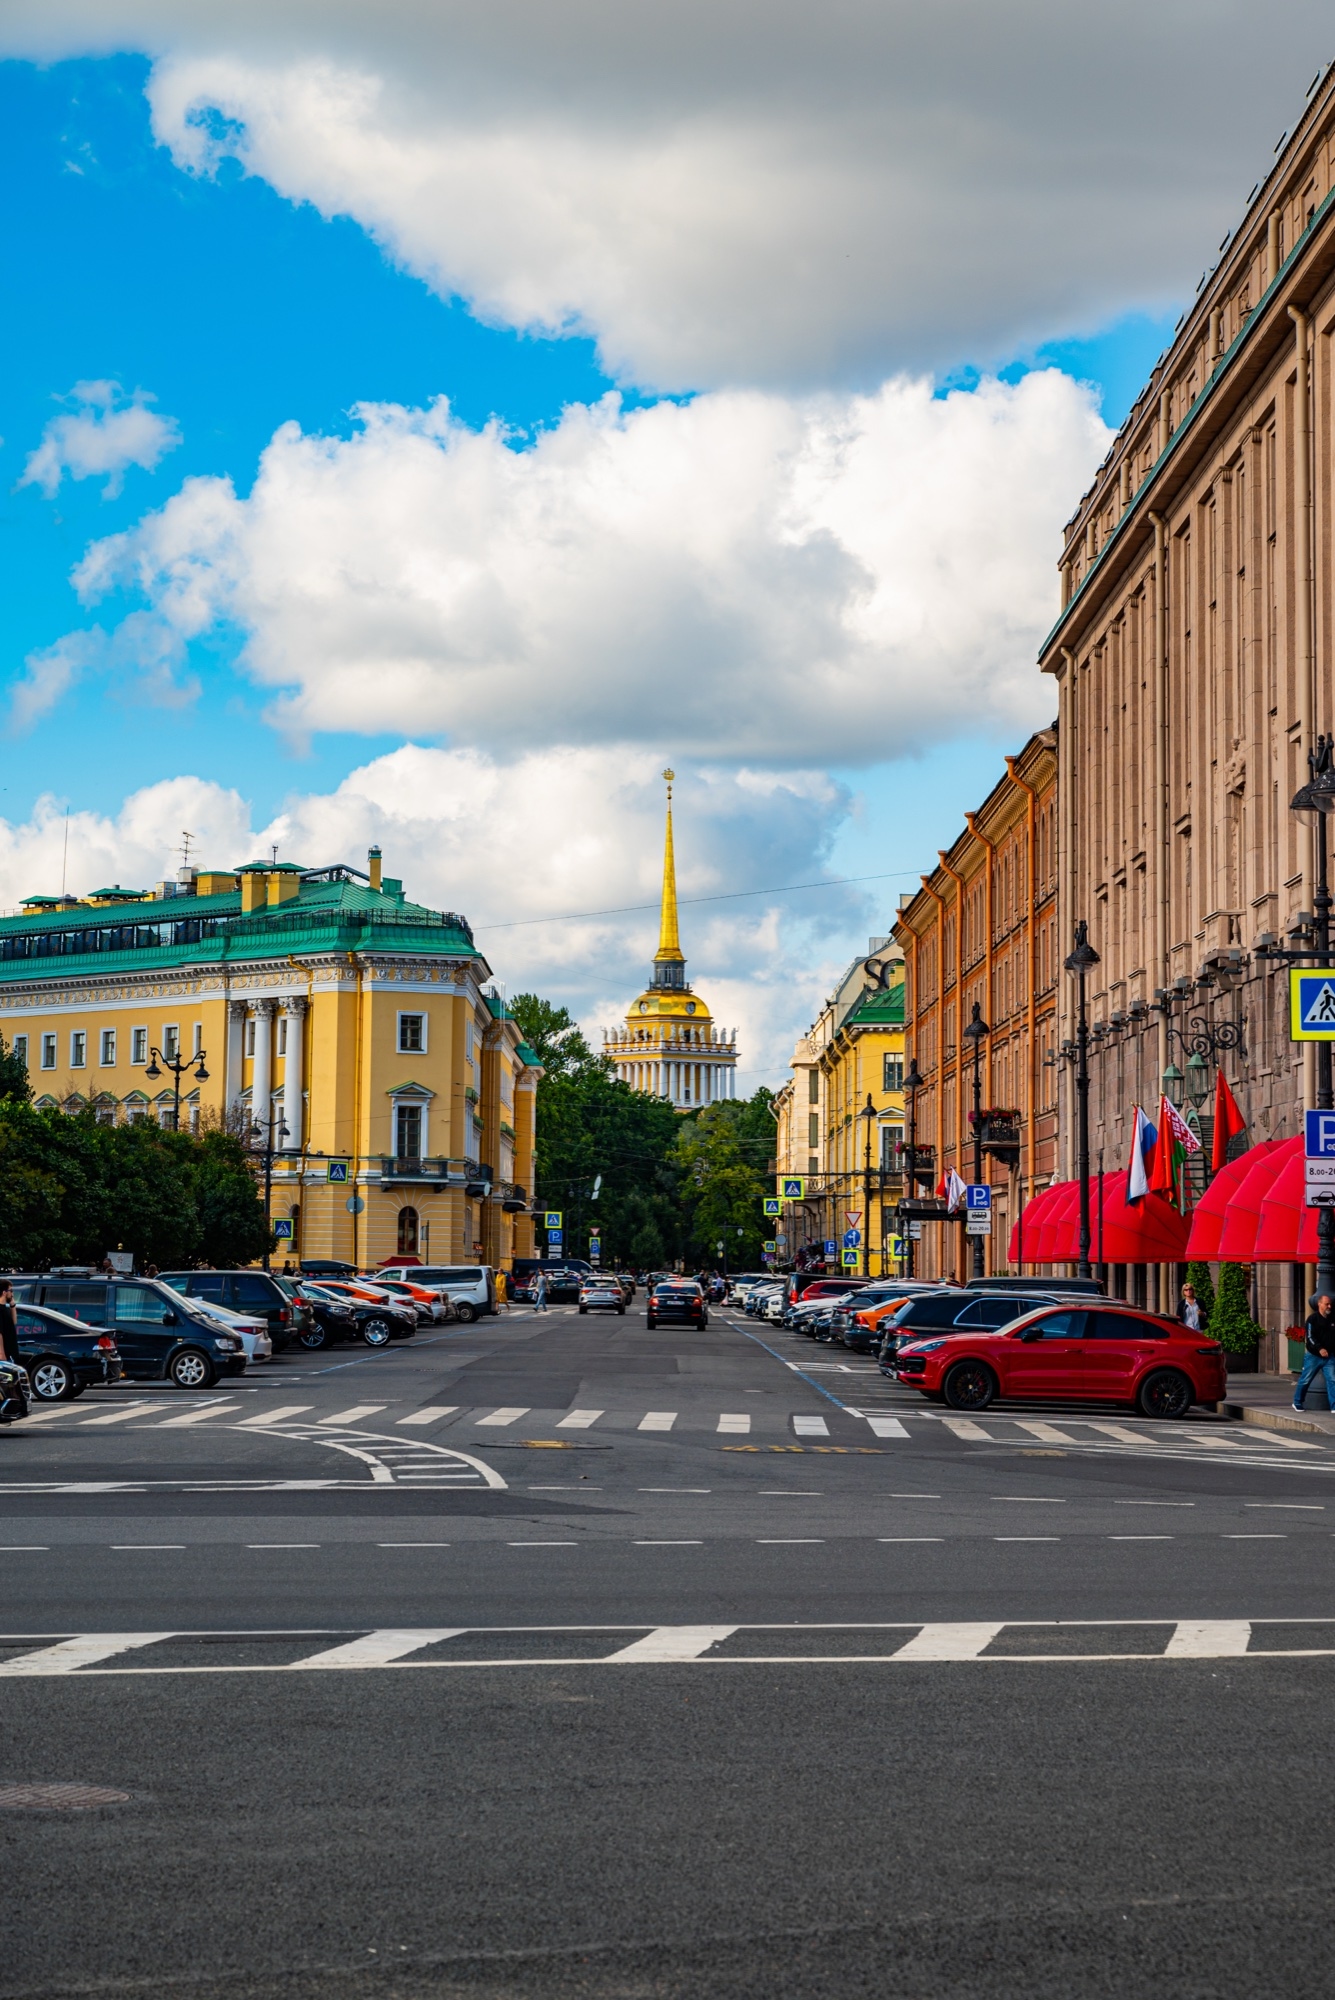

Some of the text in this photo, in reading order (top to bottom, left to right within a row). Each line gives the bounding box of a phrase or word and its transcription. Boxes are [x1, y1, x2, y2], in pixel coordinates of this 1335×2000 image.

[1309, 1167, 1335, 1175] 8.00-2
[973, 1188, 986, 1205] P
[552, 1232, 560, 1241] P
